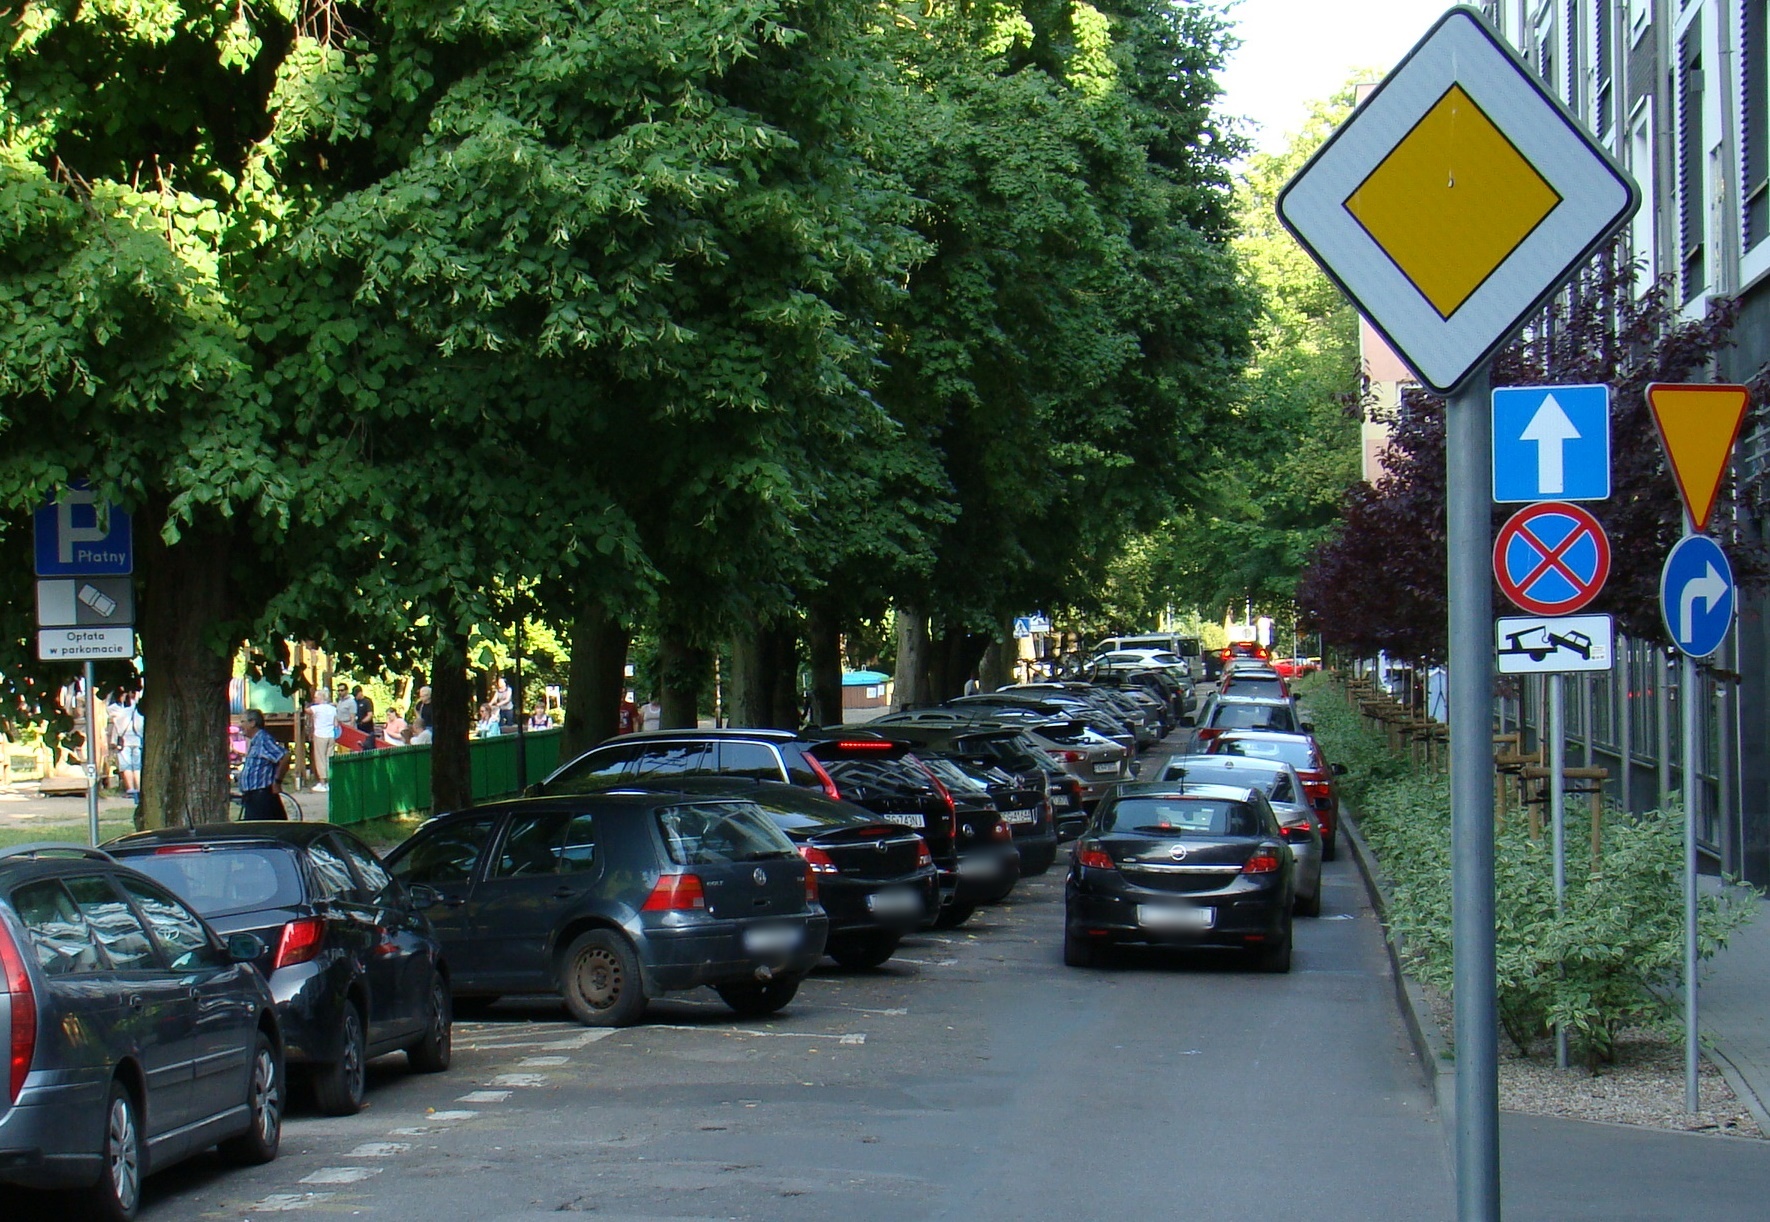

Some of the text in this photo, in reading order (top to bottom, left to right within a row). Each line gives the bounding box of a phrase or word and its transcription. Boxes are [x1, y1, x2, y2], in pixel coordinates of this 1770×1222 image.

[57, 490, 110, 563] P
[78, 550, 126, 566] Płatny
[67, 632, 105, 643] Opłata
[62, 644, 123, 656] parkomacie
